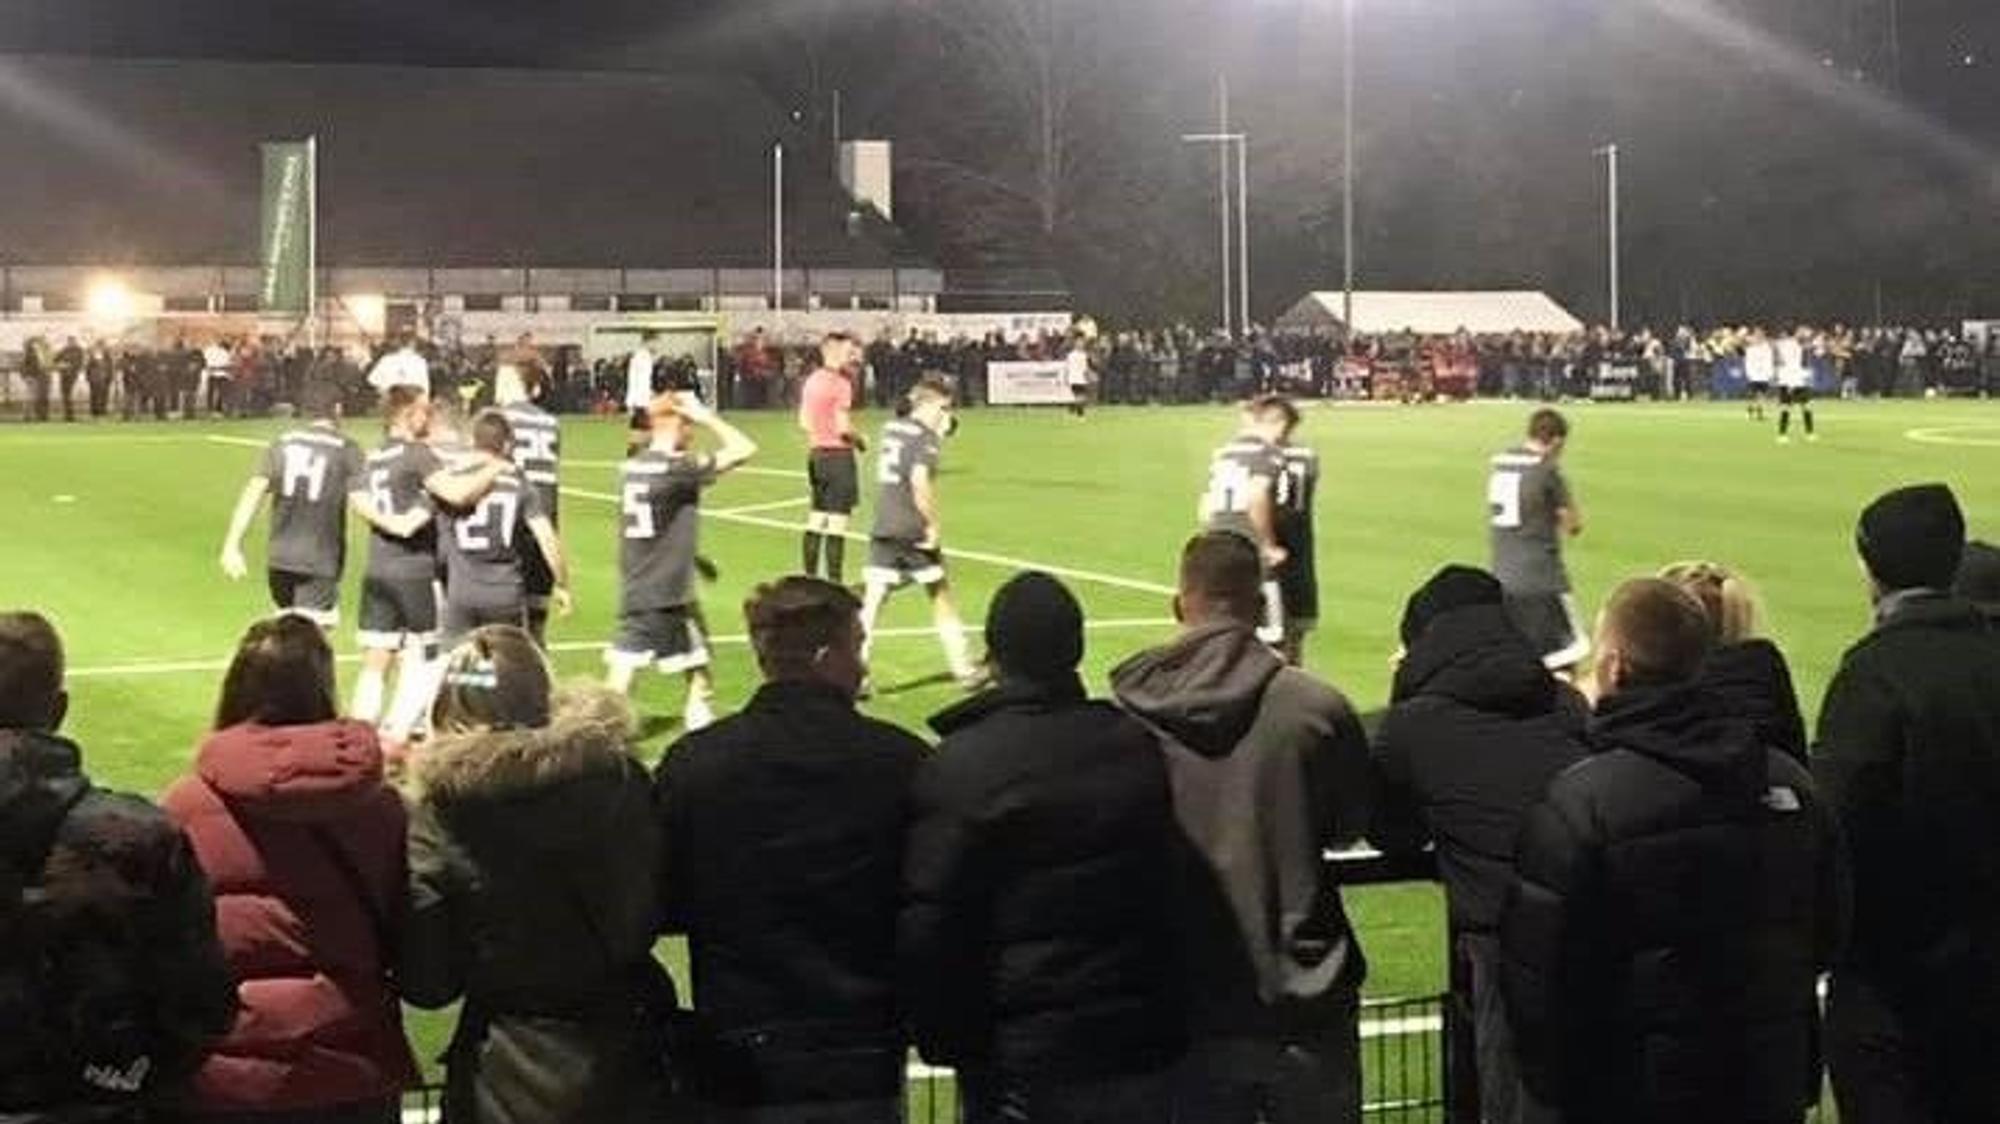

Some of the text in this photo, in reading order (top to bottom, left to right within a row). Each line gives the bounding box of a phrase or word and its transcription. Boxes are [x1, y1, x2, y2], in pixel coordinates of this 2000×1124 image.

[879, 437, 904, 483] 2
[455, 491, 519, 550] 27
[623, 482, 655, 539] 5
